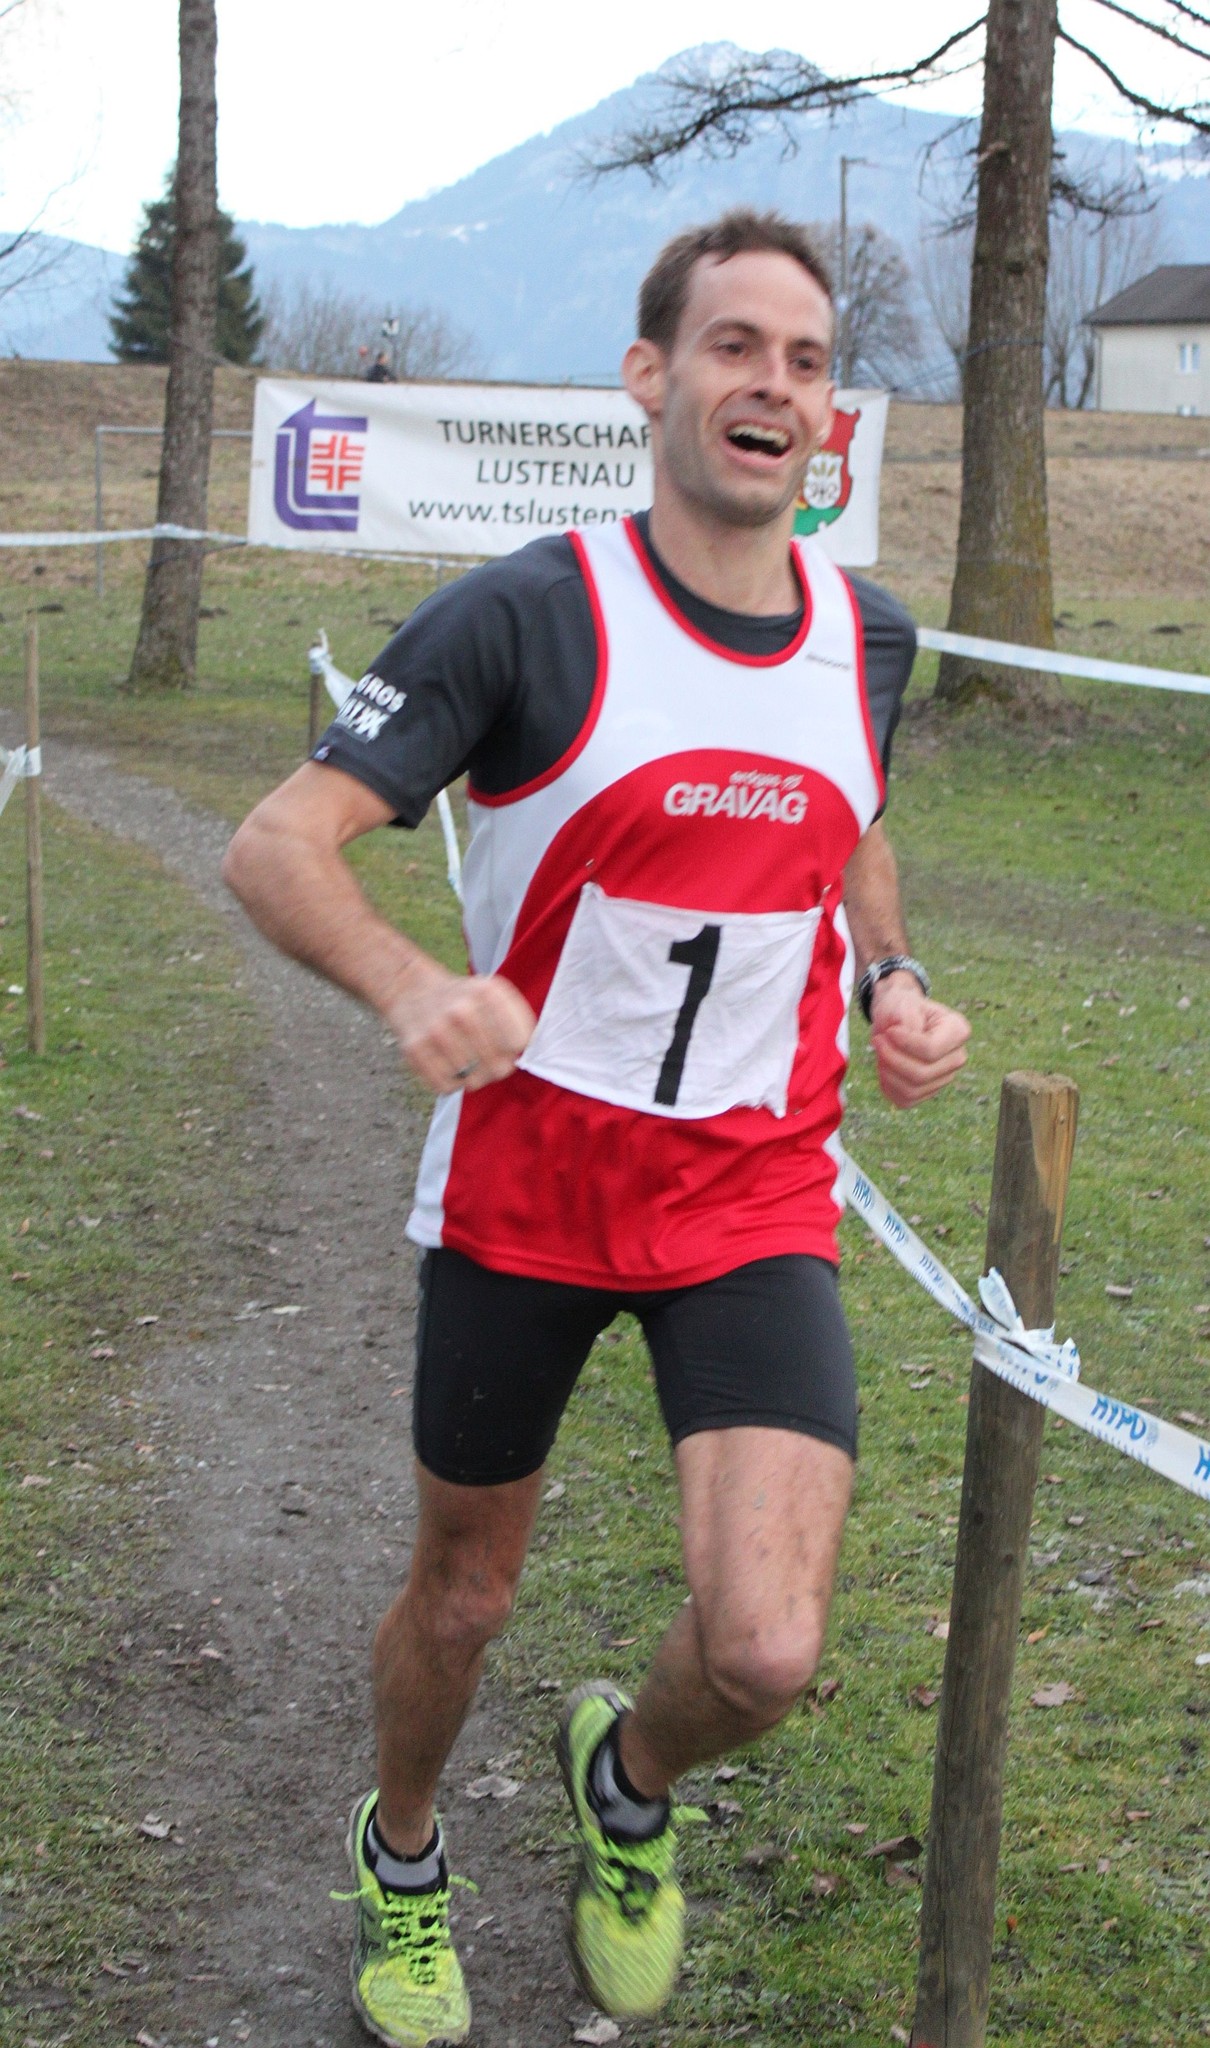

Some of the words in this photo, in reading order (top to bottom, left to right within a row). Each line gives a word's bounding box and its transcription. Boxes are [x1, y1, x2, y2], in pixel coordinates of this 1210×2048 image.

[476, 459, 636, 488] LUSTENAU
[663, 781, 809, 825] GRAVAG
[653, 923, 722, 1107] 1
